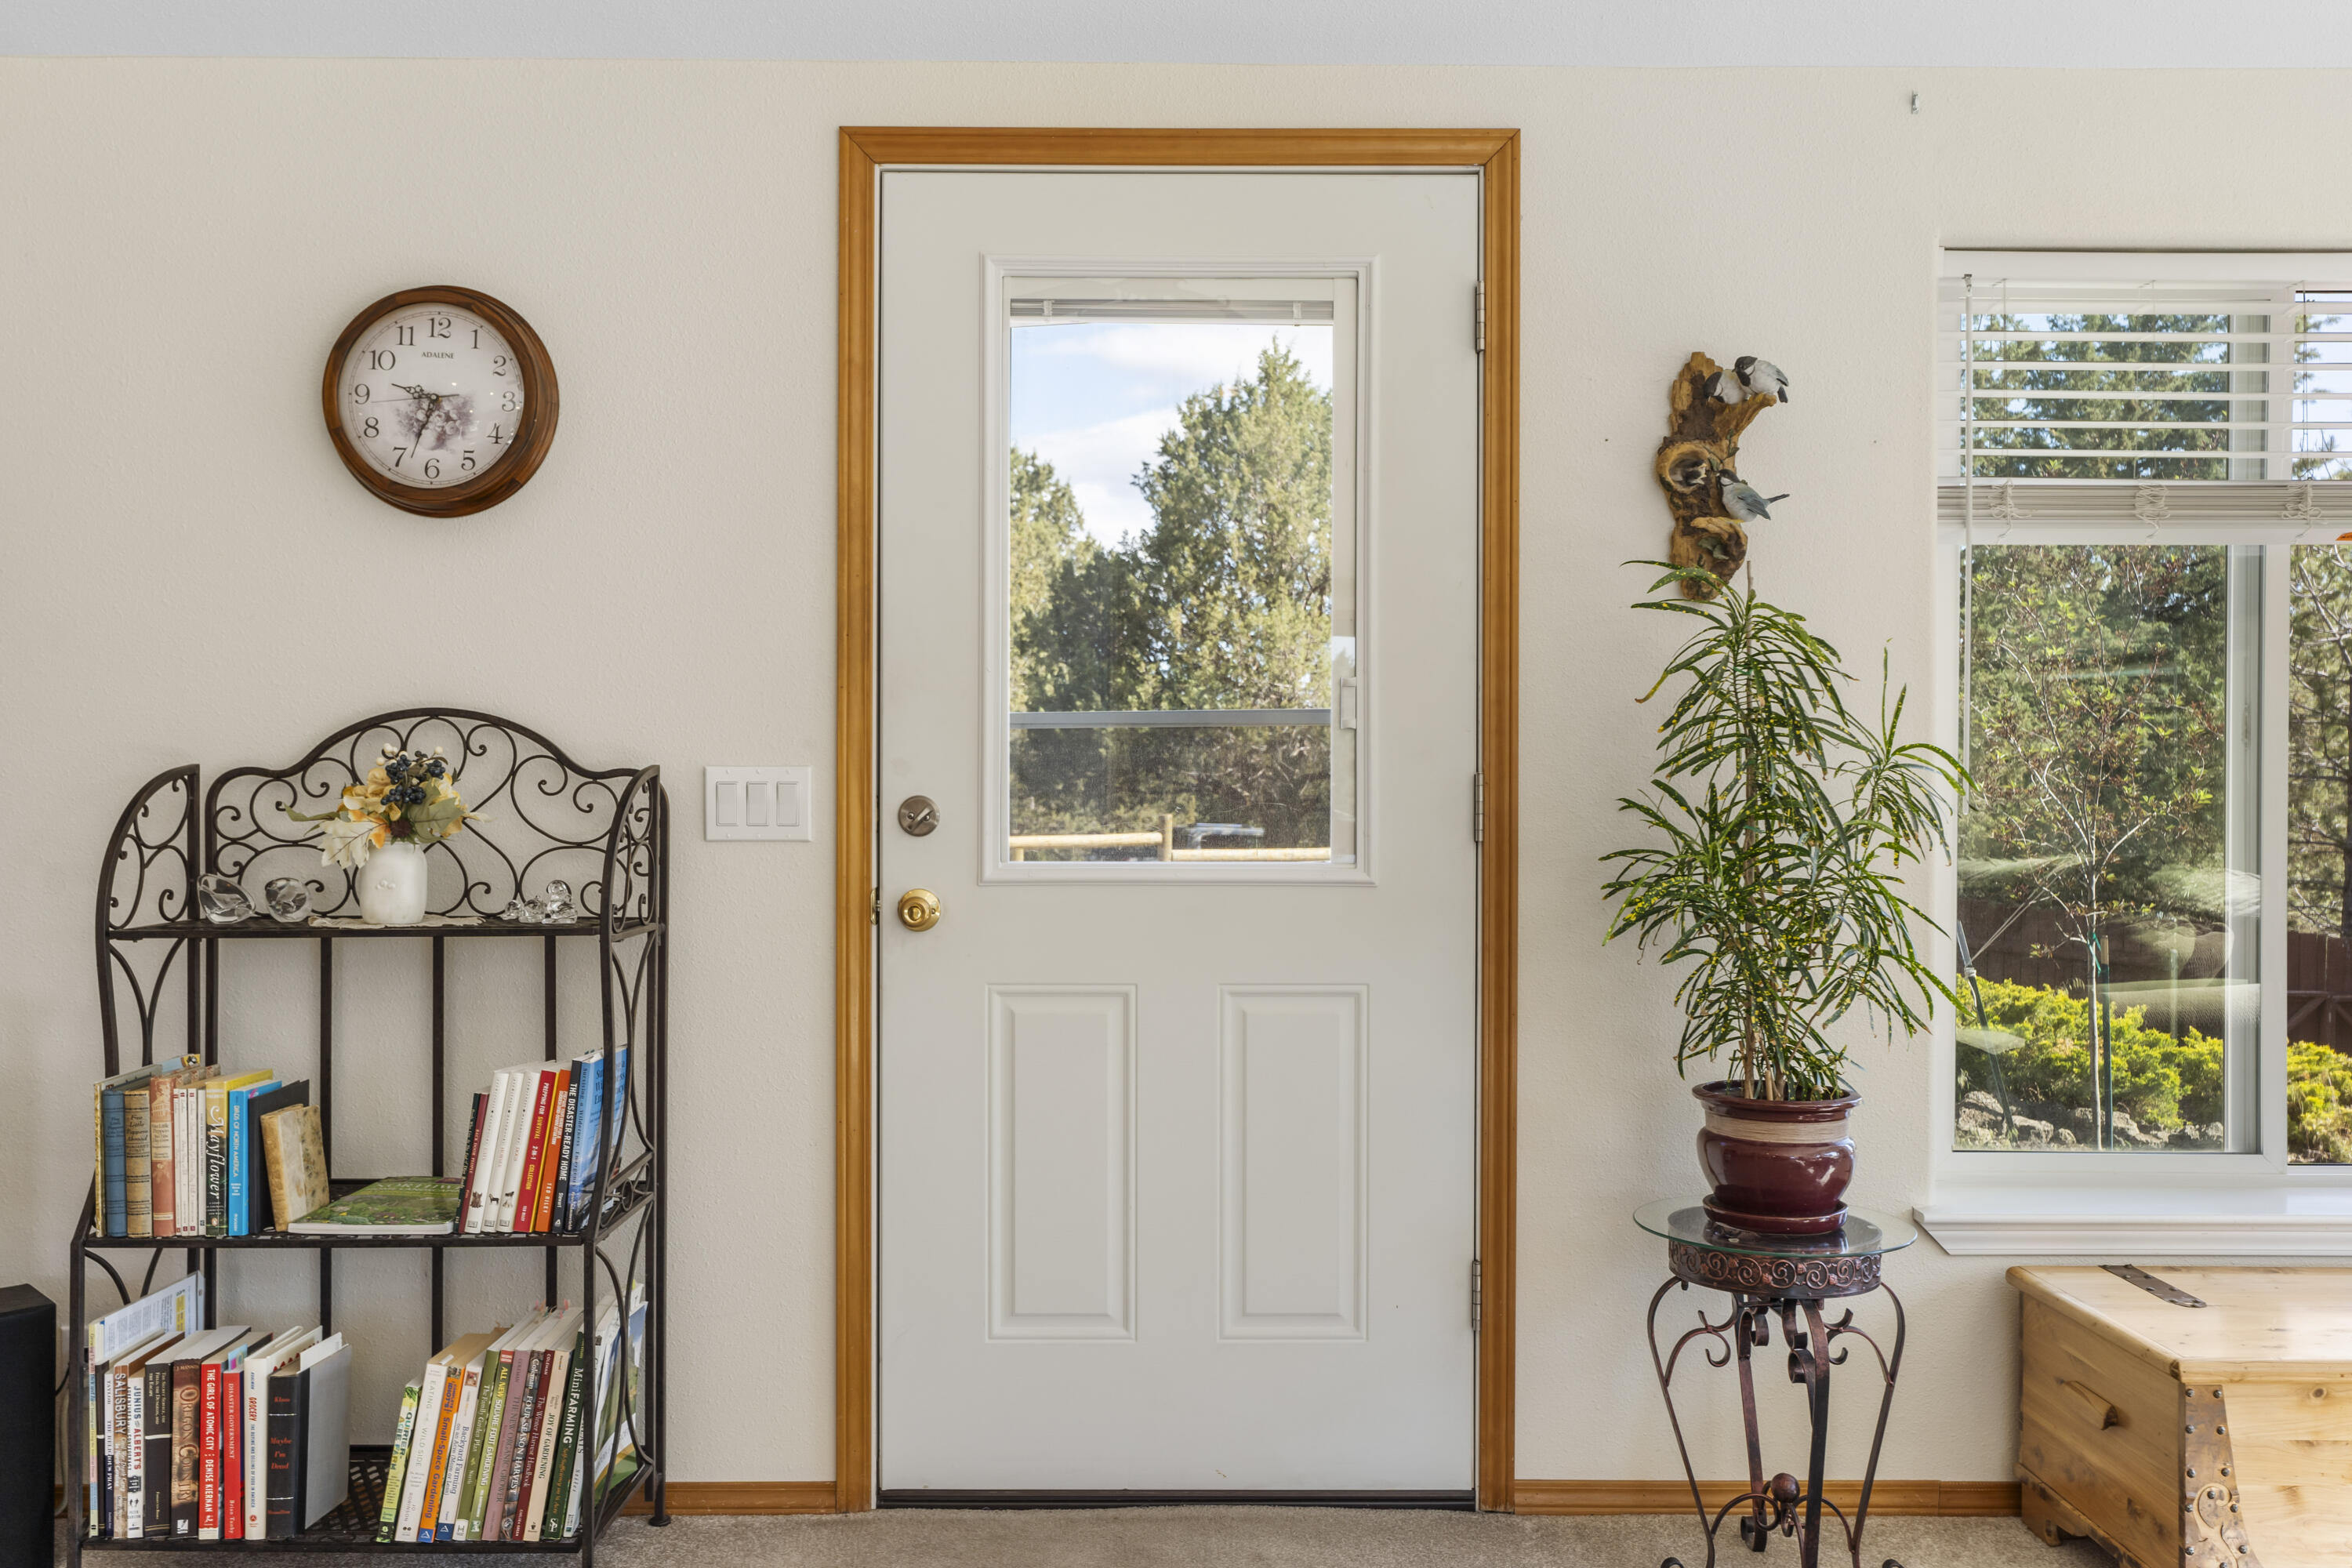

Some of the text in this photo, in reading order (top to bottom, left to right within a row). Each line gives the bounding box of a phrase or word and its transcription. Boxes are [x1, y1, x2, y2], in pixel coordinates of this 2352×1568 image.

[396, 325, 416, 346] 11
[427, 318, 452, 339] 12
[470, 329, 481, 349] 1
[368, 350, 396, 370] 10
[493, 355, 508, 376] 2
[354, 384, 370, 405] 9
[502, 391, 516, 412] 3
[364, 417, 379, 437] 8
[487, 423, 503, 445] 4
[392, 447, 407, 467] 7
[461, 450, 476, 470] 5
[424, 459, 440, 479] 6
[540, 1083, 550, 1105] PREPPING
[534, 1116, 543, 1139] SURVIVAL
[559, 1083, 578, 1181] THE DISASTER-READY HOME
[205, 1105, 226, 1200] Mayflower
[525, 1164, 535, 1190] COLLECTION
[500, 1367, 509, 1381] ALL
[426, 1380, 437, 1409] EATING
[497, 1381, 506, 1398] NEW
[114, 1373, 126, 1434] SALISBURY
[205, 1369, 216, 1450] THE GIRLS OF ATOMIC CITY
[249, 1396, 258, 1421] GROCERY
[479, 1396, 488, 1415] Family
[491, 1399, 503, 1426] SQUARE
[563, 1367, 584, 1444] MiniFARMING
[475, 1417, 485, 1437] Garden
[510, 1358, 539, 1496] Coleman FOUR SEASON HARVEST
[533, 1411, 543, 1431] Winter
[545, 1428, 553, 1437] OF
[419, 1428, 427, 1448] WILD
[457, 1425, 470, 1461] Backyard
[488, 1428, 497, 1445] FOOT
[529, 1432, 539, 1456] Harvest
[390, 1444, 400, 1470] FARM
[416, 1450, 424, 1468] SIDE
[503, 1432, 514, 1465] ORGANIC
[539, 1439, 550, 1479] GARDENING
[425, 1417, 450, 1518] Small-Space Gardening
[481, 1446, 494, 1486] GARDENING
[523, 1457, 535, 1487] Handbook
[205, 1459, 214, 1512] DENISE KIERNAN
[450, 1463, 463, 1494] Farming
[496, 1469, 508, 1502] GROWER
[404, 1492, 413, 1522] ROBINSON
